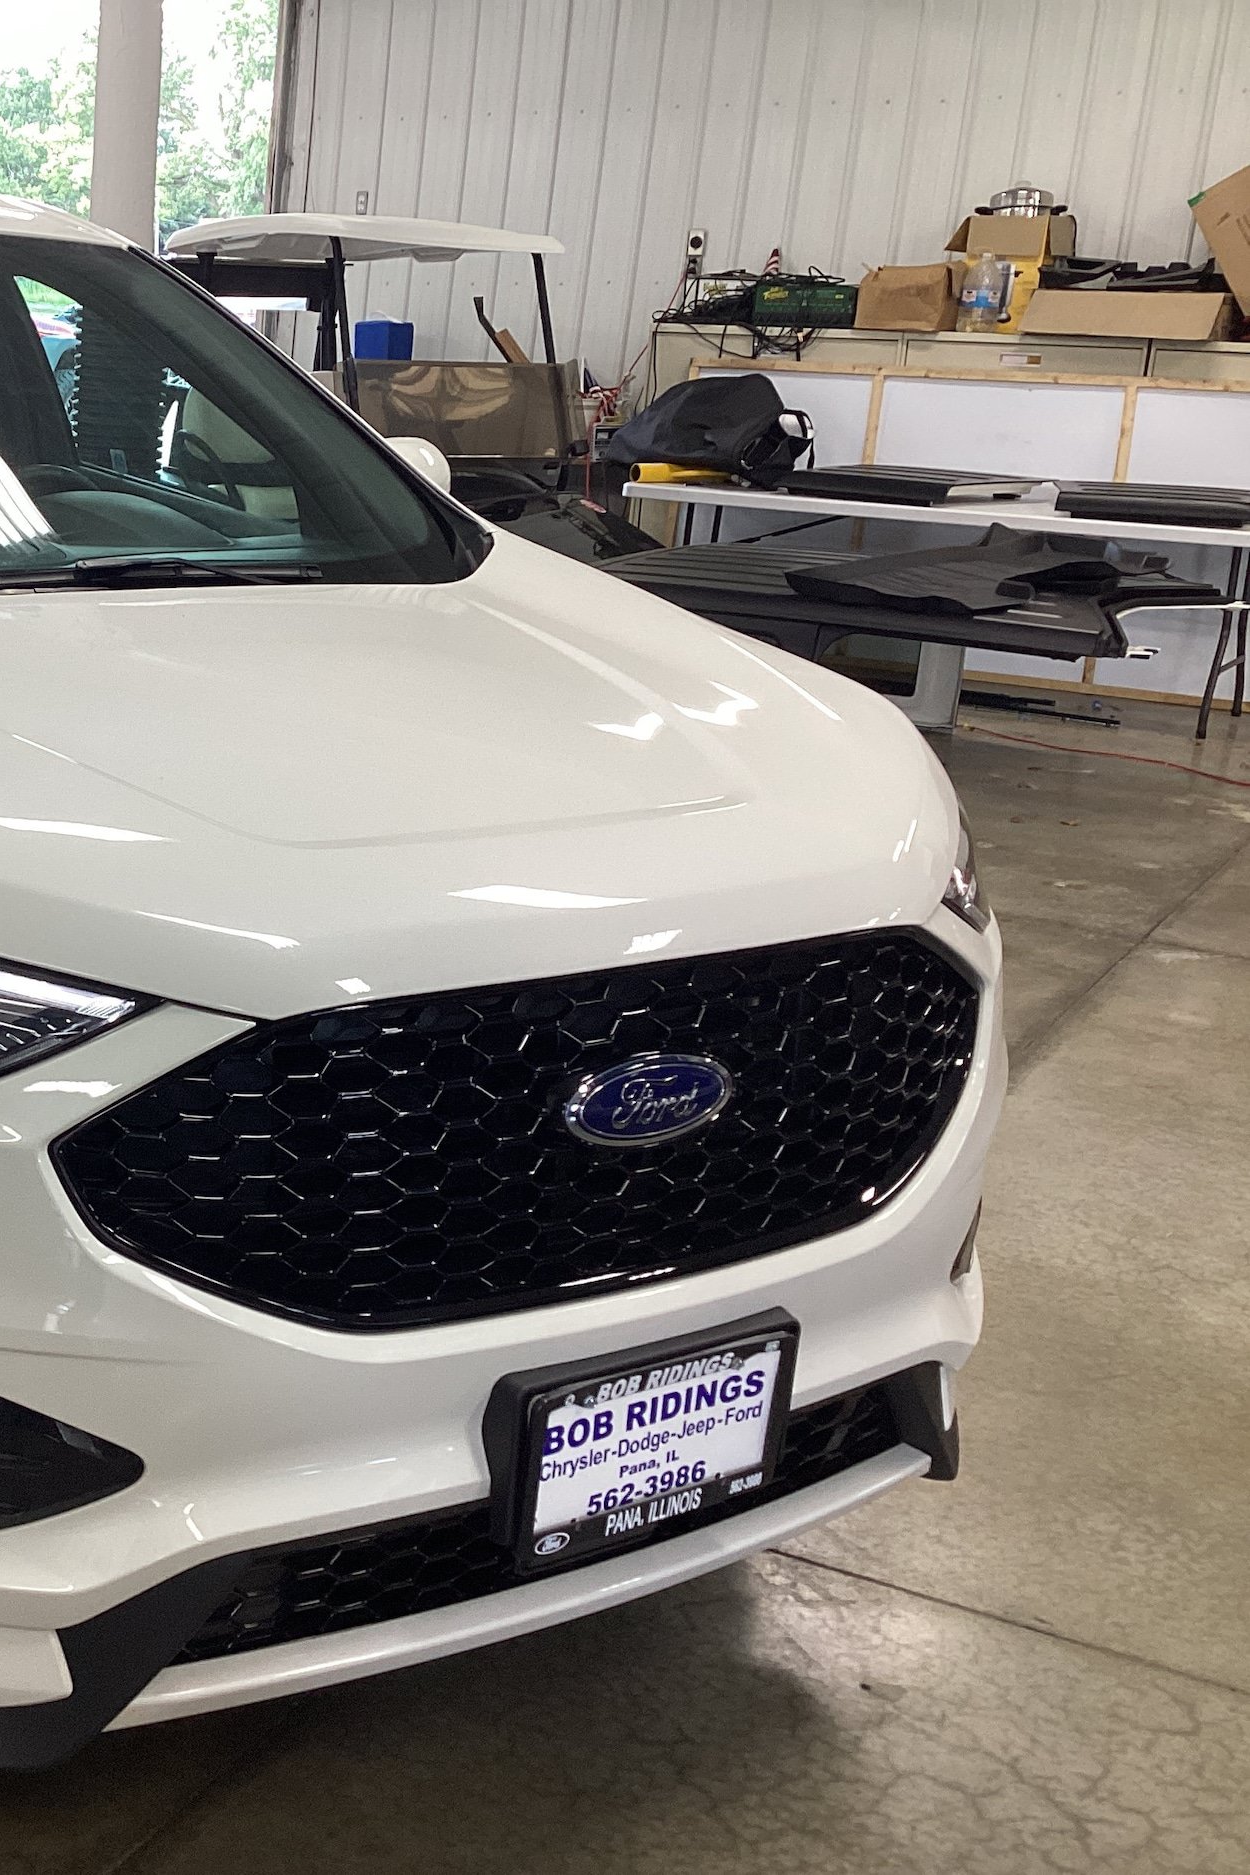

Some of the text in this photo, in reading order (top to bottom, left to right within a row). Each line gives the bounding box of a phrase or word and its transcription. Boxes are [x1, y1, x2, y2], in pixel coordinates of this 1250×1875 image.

[611, 1074, 700, 1130] Ford
[598, 1351, 735, 1402] BOB RIDINGS
[541, 1370, 765, 1456] BOB RIDINGS
[539, 1401, 763, 1482] Chrysler-Dodge-Jeep-Ford
[666, 1449, 680, 1464] IL
[586, 1460, 706, 1518] 562-3986
[648, 1487, 703, 1524] ILLINOIS
